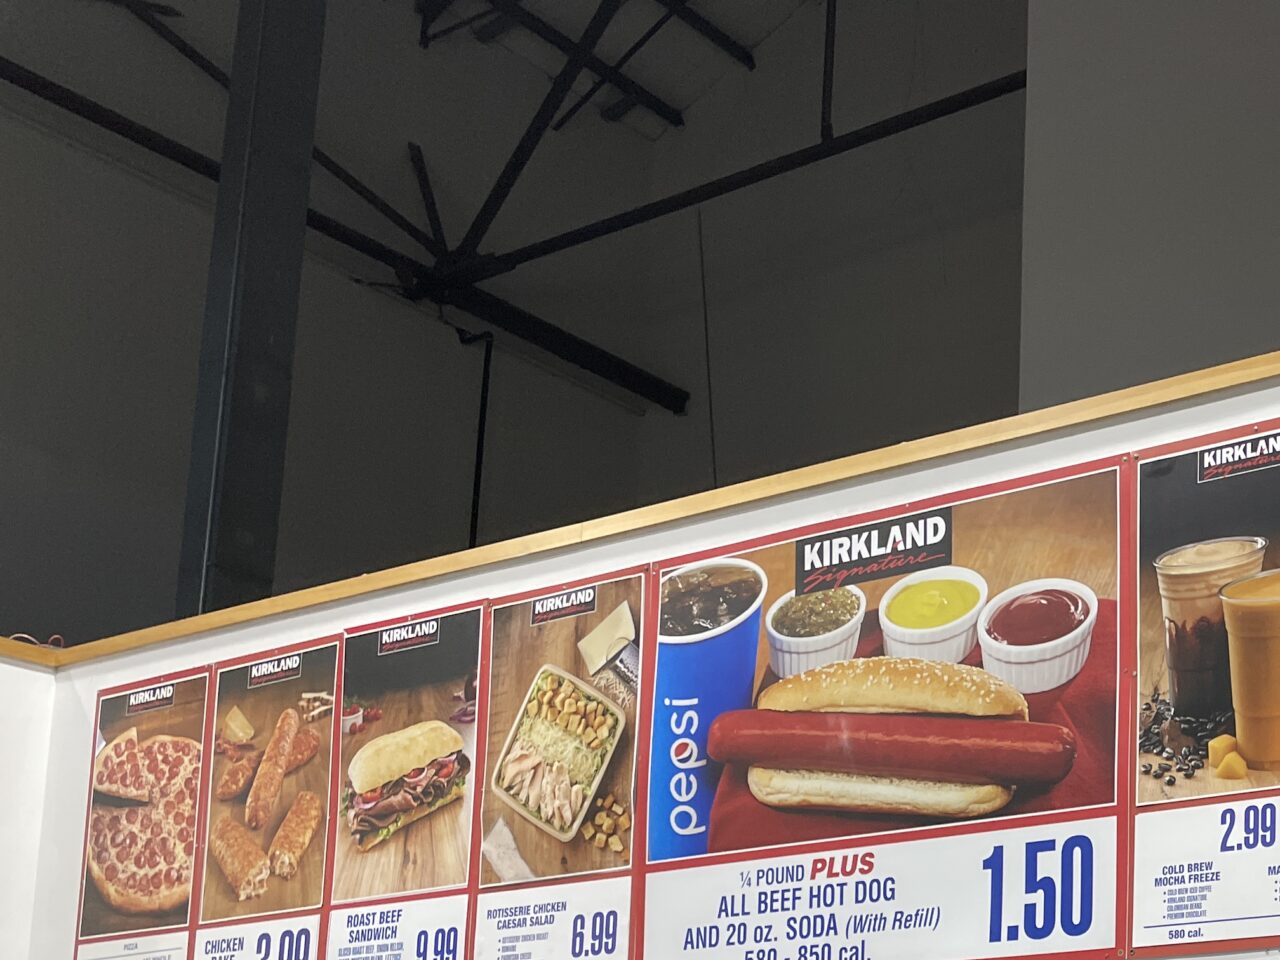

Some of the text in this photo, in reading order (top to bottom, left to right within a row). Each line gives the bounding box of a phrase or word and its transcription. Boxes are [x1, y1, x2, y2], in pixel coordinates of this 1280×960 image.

[804, 516, 947, 571] KIRKLAND
[803, 551, 945, 593] Signature
[535, 589, 594, 614] KIRKLAND
[382, 621, 437, 644] KIRKLAND
[251, 656, 300, 678] KIRKLAND
[130, 686, 173, 706] KIRKLAND
[664, 697, 708, 836] pepsi
[1220, 803, 1277, 853] 2.99
[756, 865, 805, 886] POUND
[810, 852, 875, 880] PLUS
[1154, 872, 1221, 887] MOCHA FREEZE
[1162, 861, 1214, 876] COLD BREW
[717, 877, 896, 919] ALL BEEF HOT DOG
[982, 834, 1093, 944] 1.50
[347, 909, 403, 929] ROAST BEEF
[486, 901, 567, 920] ROTISSERIE CHICKEN
[497, 915, 555, 930] CAESAR SALAD
[571, 910, 618, 958] 6.99
[683, 906, 941, 950] AND 20 oz. SODA (With Refill)
[1168, 927, 1204, 939] 580 cal.
[204, 937, 245, 955] CHICKEN
[348, 926, 398, 944] SANDWICH
